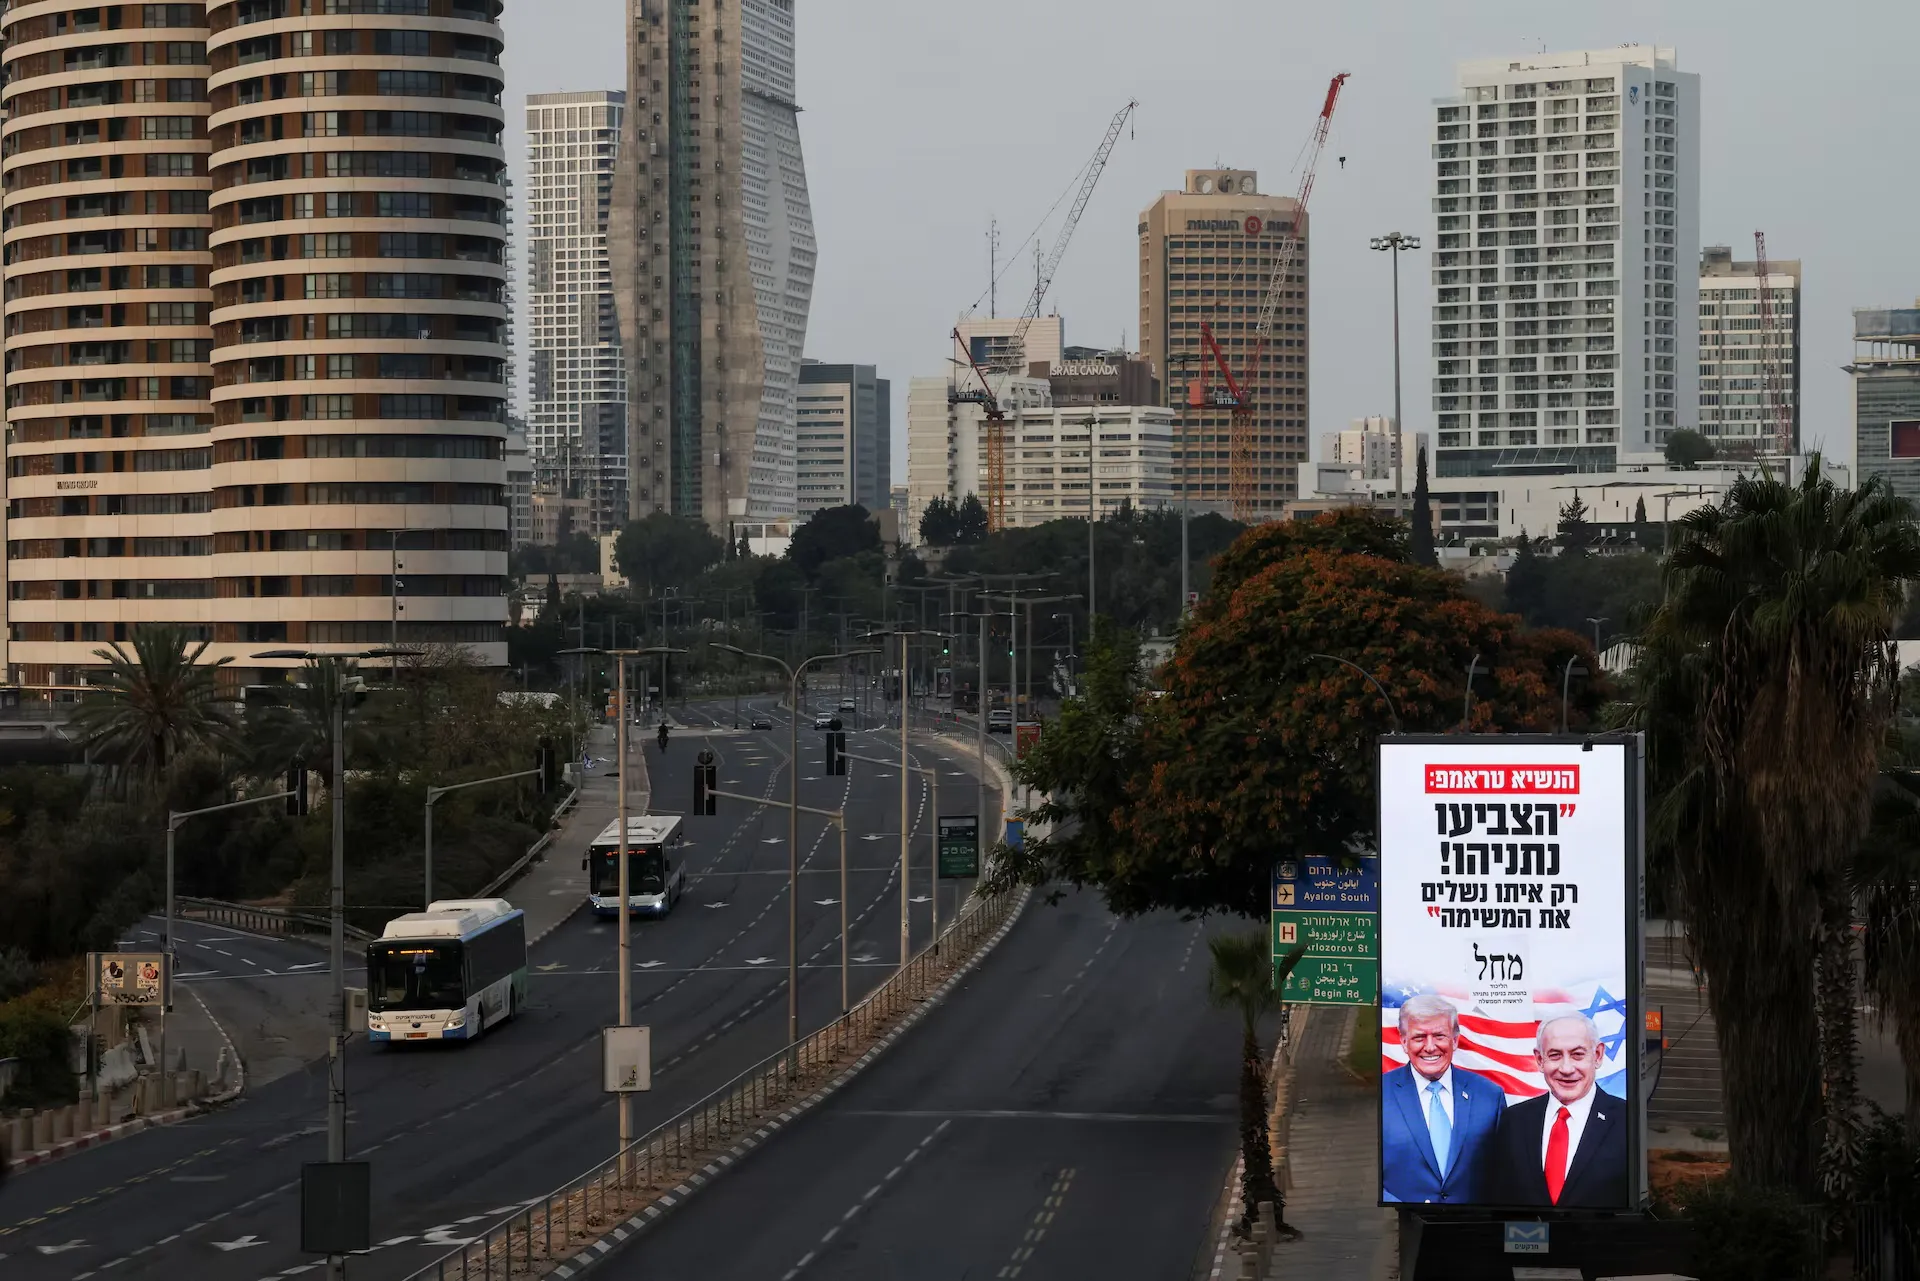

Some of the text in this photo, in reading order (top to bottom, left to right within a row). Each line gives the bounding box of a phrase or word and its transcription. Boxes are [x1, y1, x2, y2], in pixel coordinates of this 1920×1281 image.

[1051, 365, 1118, 376] ISRAEL CANADA
[1429, 769, 1575, 789] הנשיא טראמפ:
[1440, 841, 1560, 876] נתניהו!
[1308, 866, 1332, 876] דרום
[1303, 891, 1370, 903] Ayalon South
[1421, 880, 1578, 907] רק איתו נשלים
[1302, 916, 1350, 927] ארלוזורוב
[1539, 909, 1571, 929] את
[1282, 925, 1294, 940] H
[1347, 929, 1366, 941] شارع
[1357, 943, 1369, 953] St
[1472, 942, 1524, 981] מחל
[1320, 962, 1339, 974] בגין
[1337, 975, 1359, 986] طريق
[1313, 988, 1360, 1000] Begin Rd
